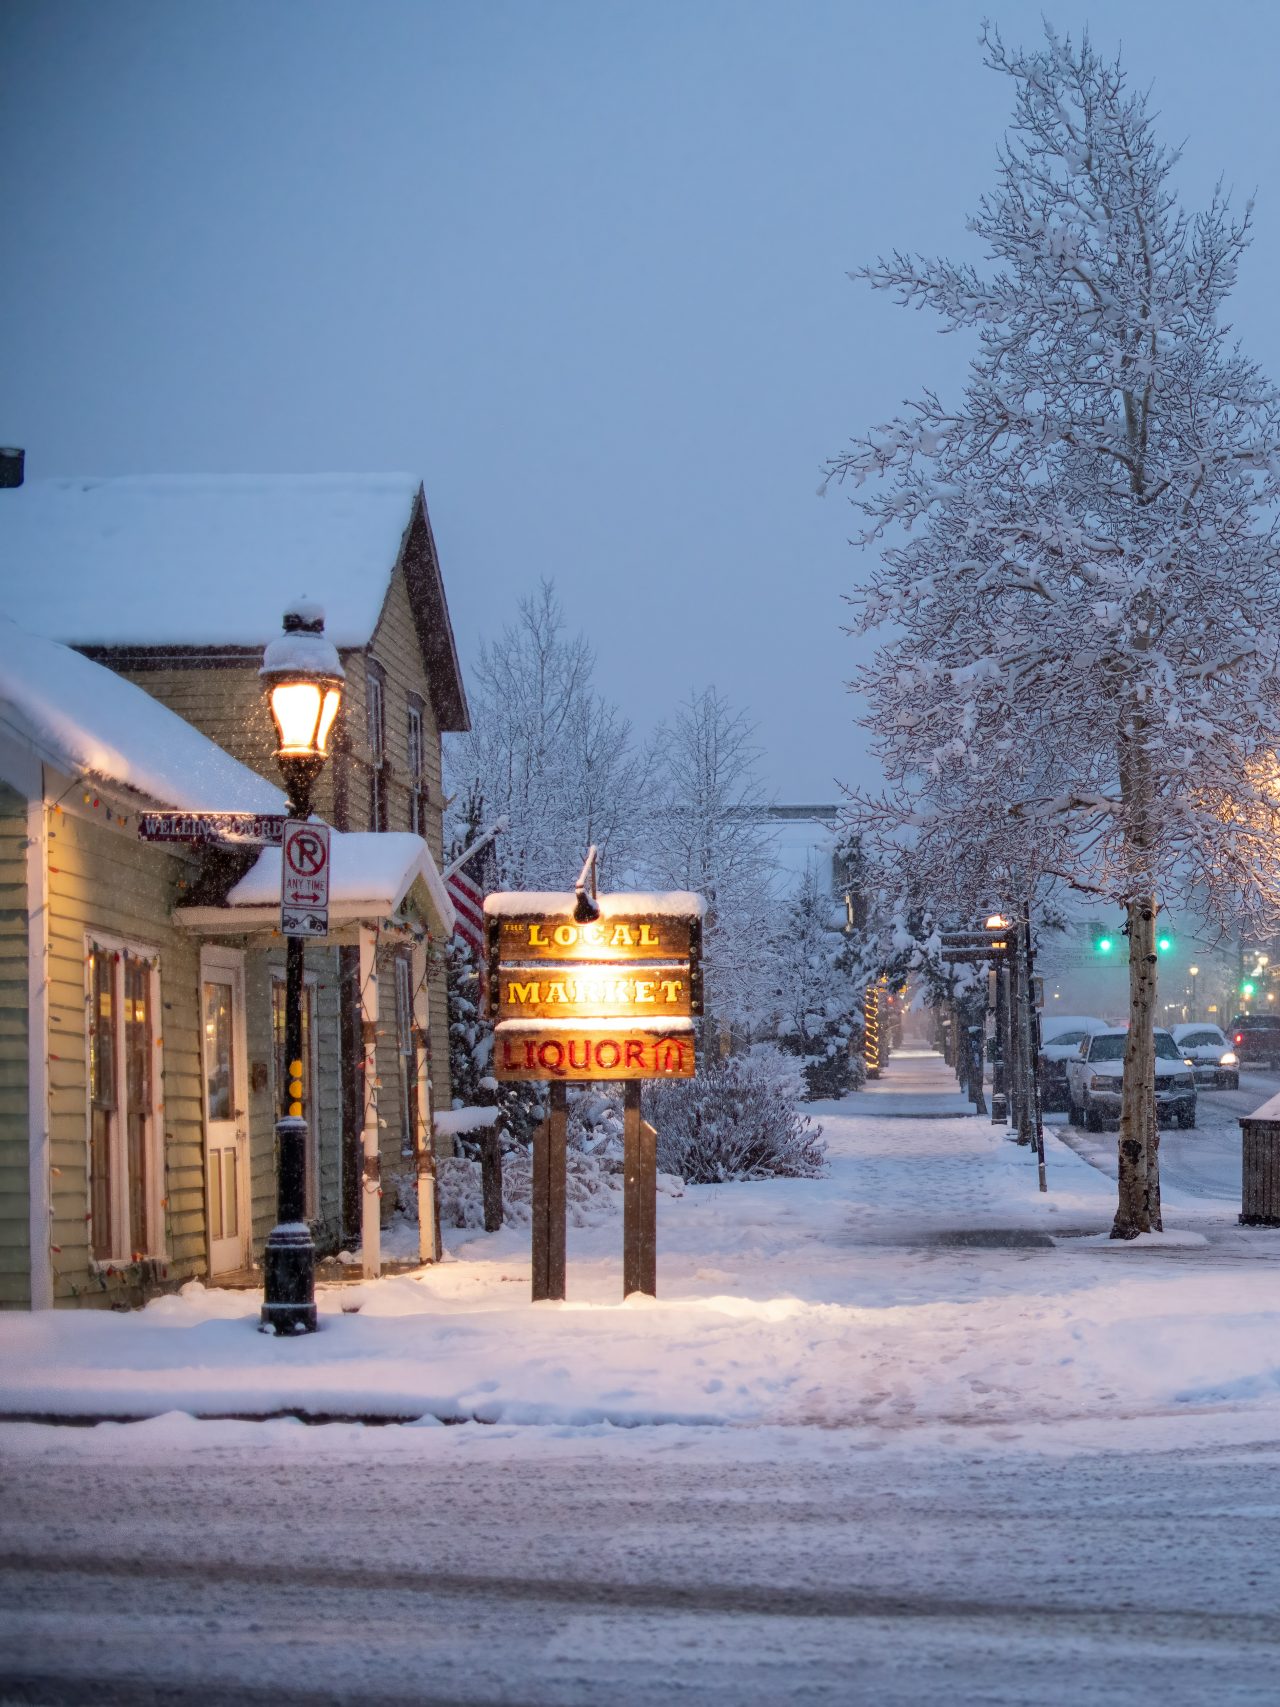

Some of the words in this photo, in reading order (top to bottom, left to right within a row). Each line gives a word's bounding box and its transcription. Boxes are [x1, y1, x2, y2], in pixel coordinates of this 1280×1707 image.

[145, 819, 257, 837] WELLINON
[287, 878, 303, 890] ANY
[307, 879, 325, 891] TIME
[528, 924, 659, 945] LOCAL
[508, 980, 682, 1003] MARKET
[503, 1039, 648, 1075] LIQUOR
